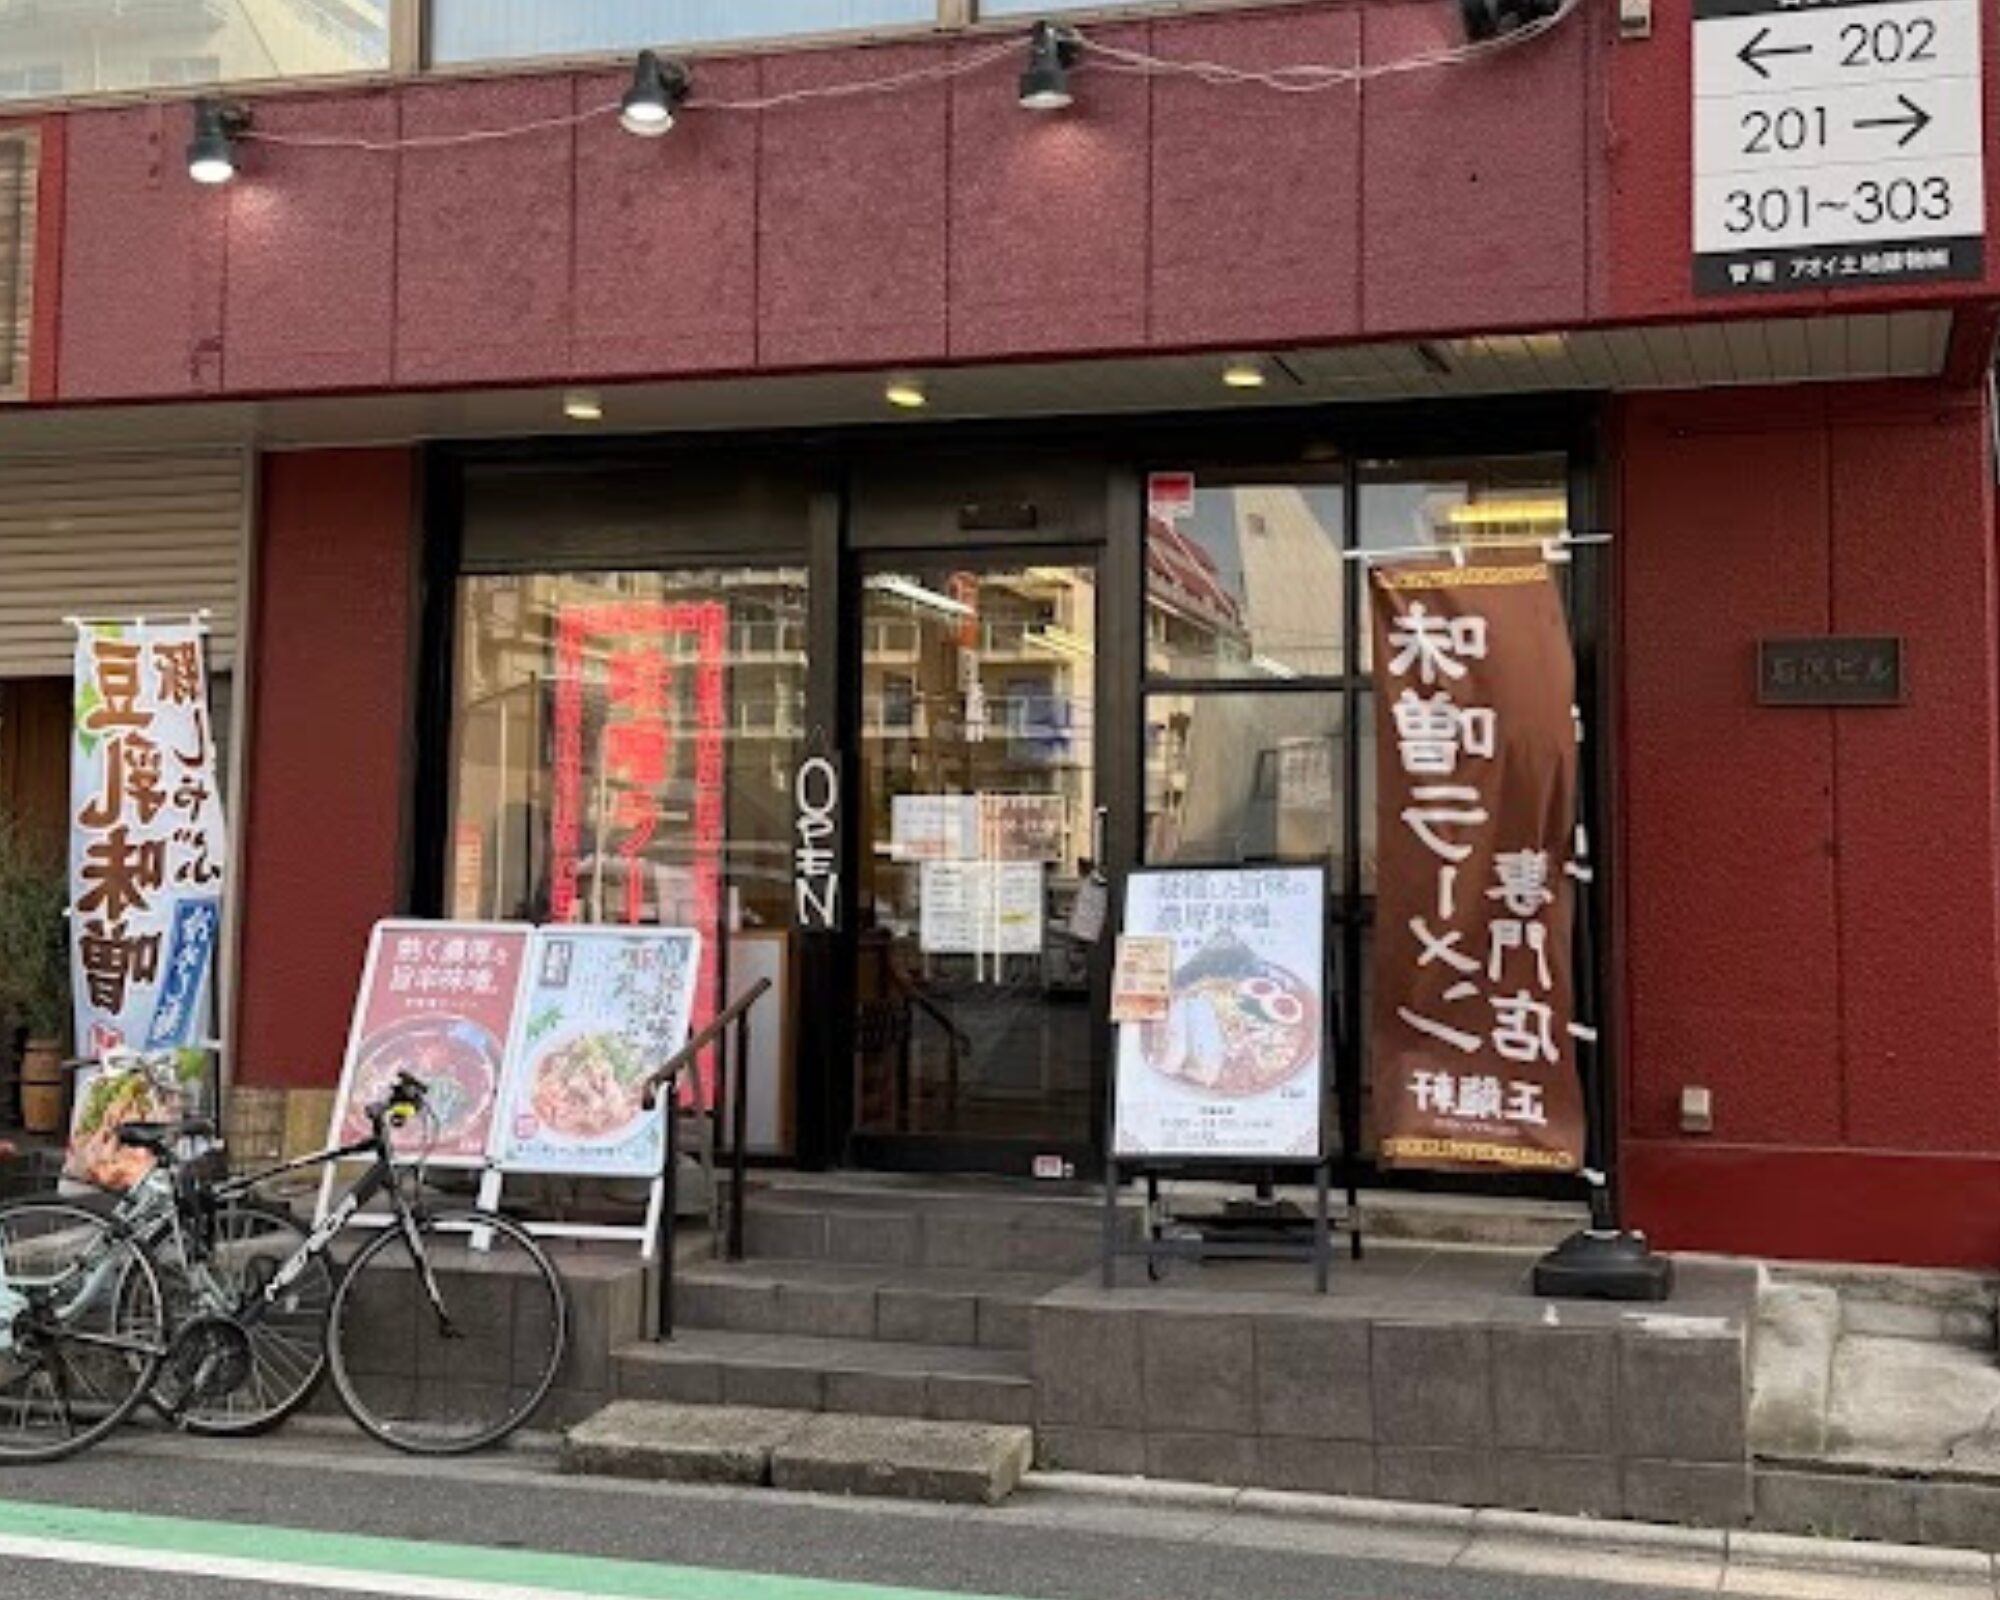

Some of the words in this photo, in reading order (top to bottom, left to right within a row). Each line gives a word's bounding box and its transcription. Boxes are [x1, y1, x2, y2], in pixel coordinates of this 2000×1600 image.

[1839, 18, 1937, 67] 202
[1741, 106, 1827, 154] 201
[795, 757, 839, 928] OPEN
